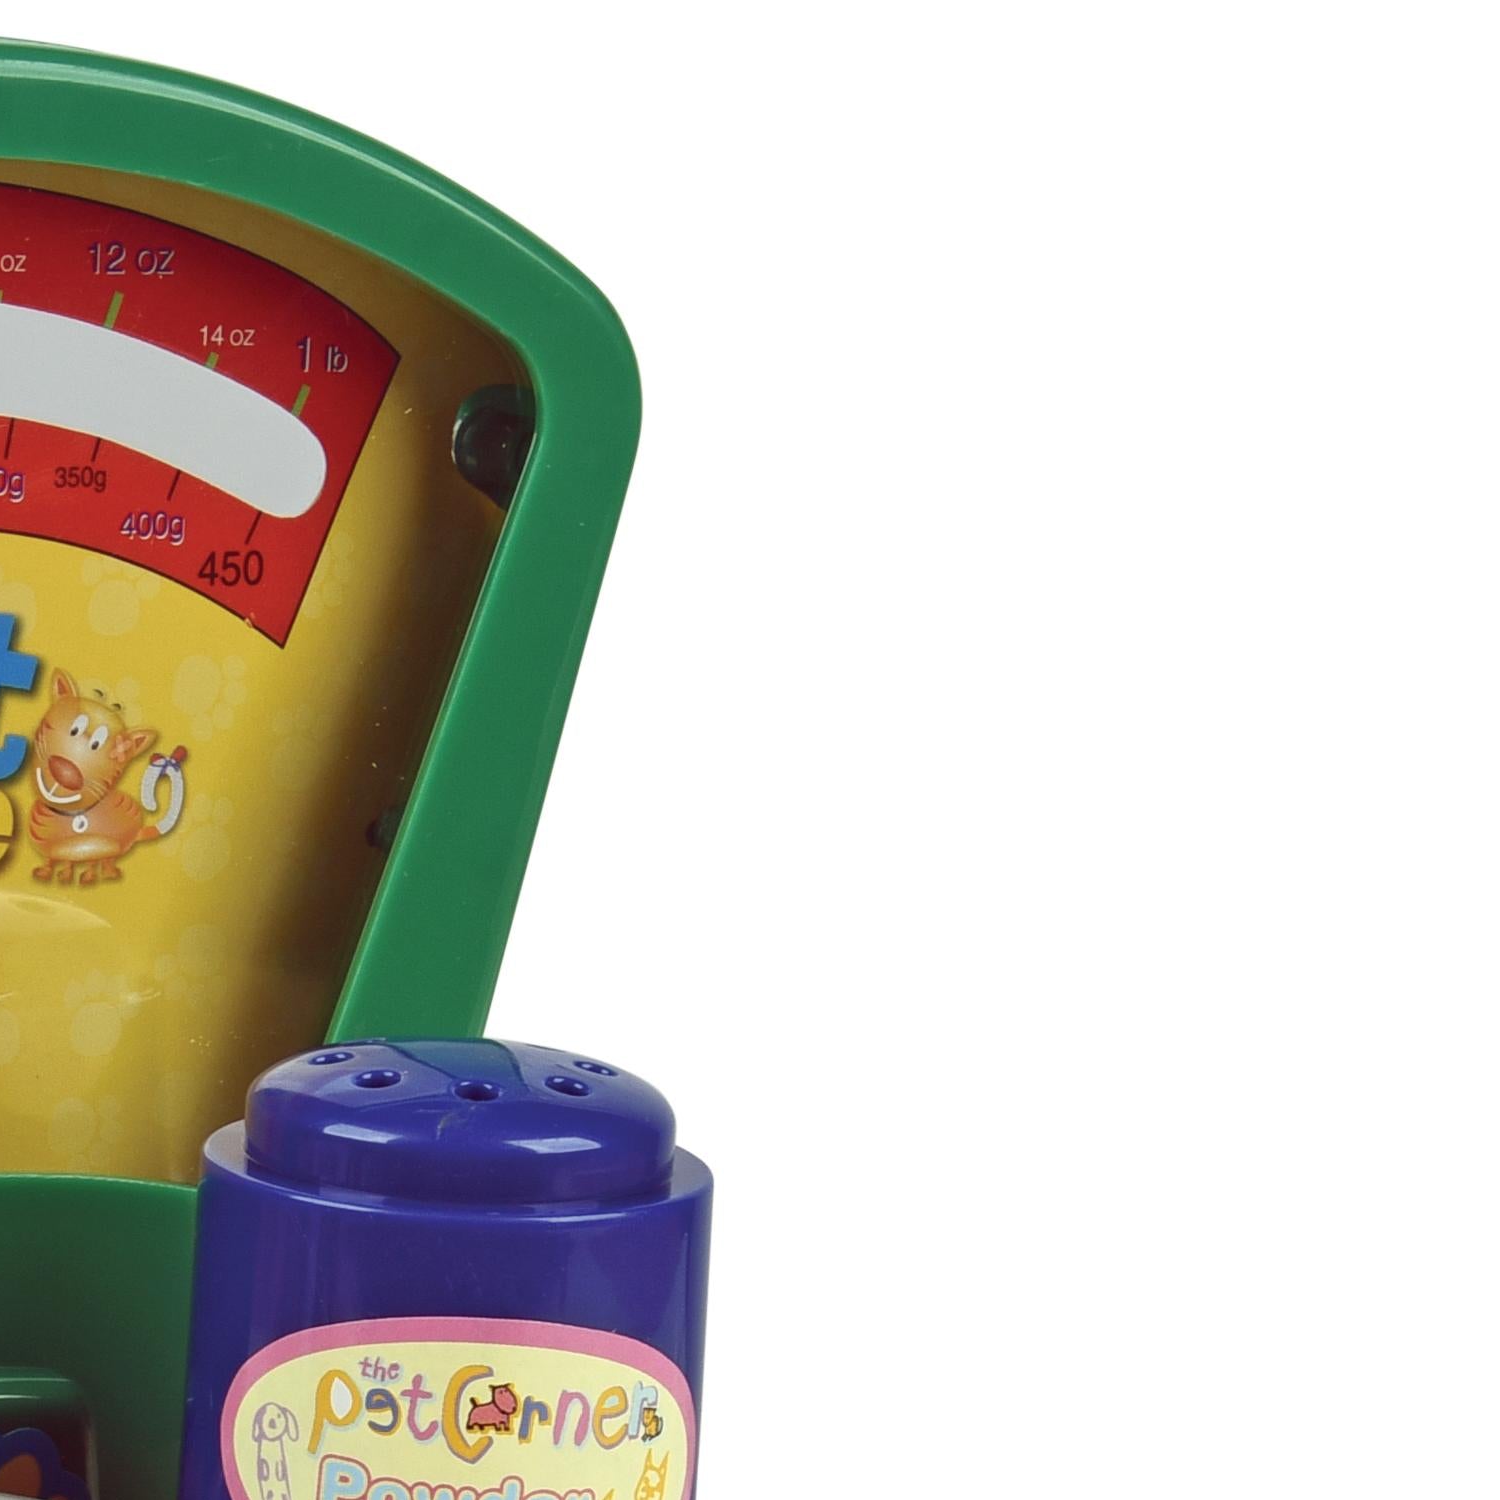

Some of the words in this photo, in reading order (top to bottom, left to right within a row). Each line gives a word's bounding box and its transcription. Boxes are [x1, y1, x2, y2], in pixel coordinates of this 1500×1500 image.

[0, 255, 27, 273] oz
[88, 242, 128, 275] 12
[137, 247, 175, 276] oz
[199, 326, 225, 346] 14
[229, 328, 255, 347] oz
[297, 337, 312, 373] 1
[327, 346, 349, 373] lb
[54, 467, 107, 491] 350g
[120, 513, 187, 546] 400g
[198, 551, 265, 587] 450
[359, 1356, 400, 1382] the
[441, 1364, 660, 1465] Crner
